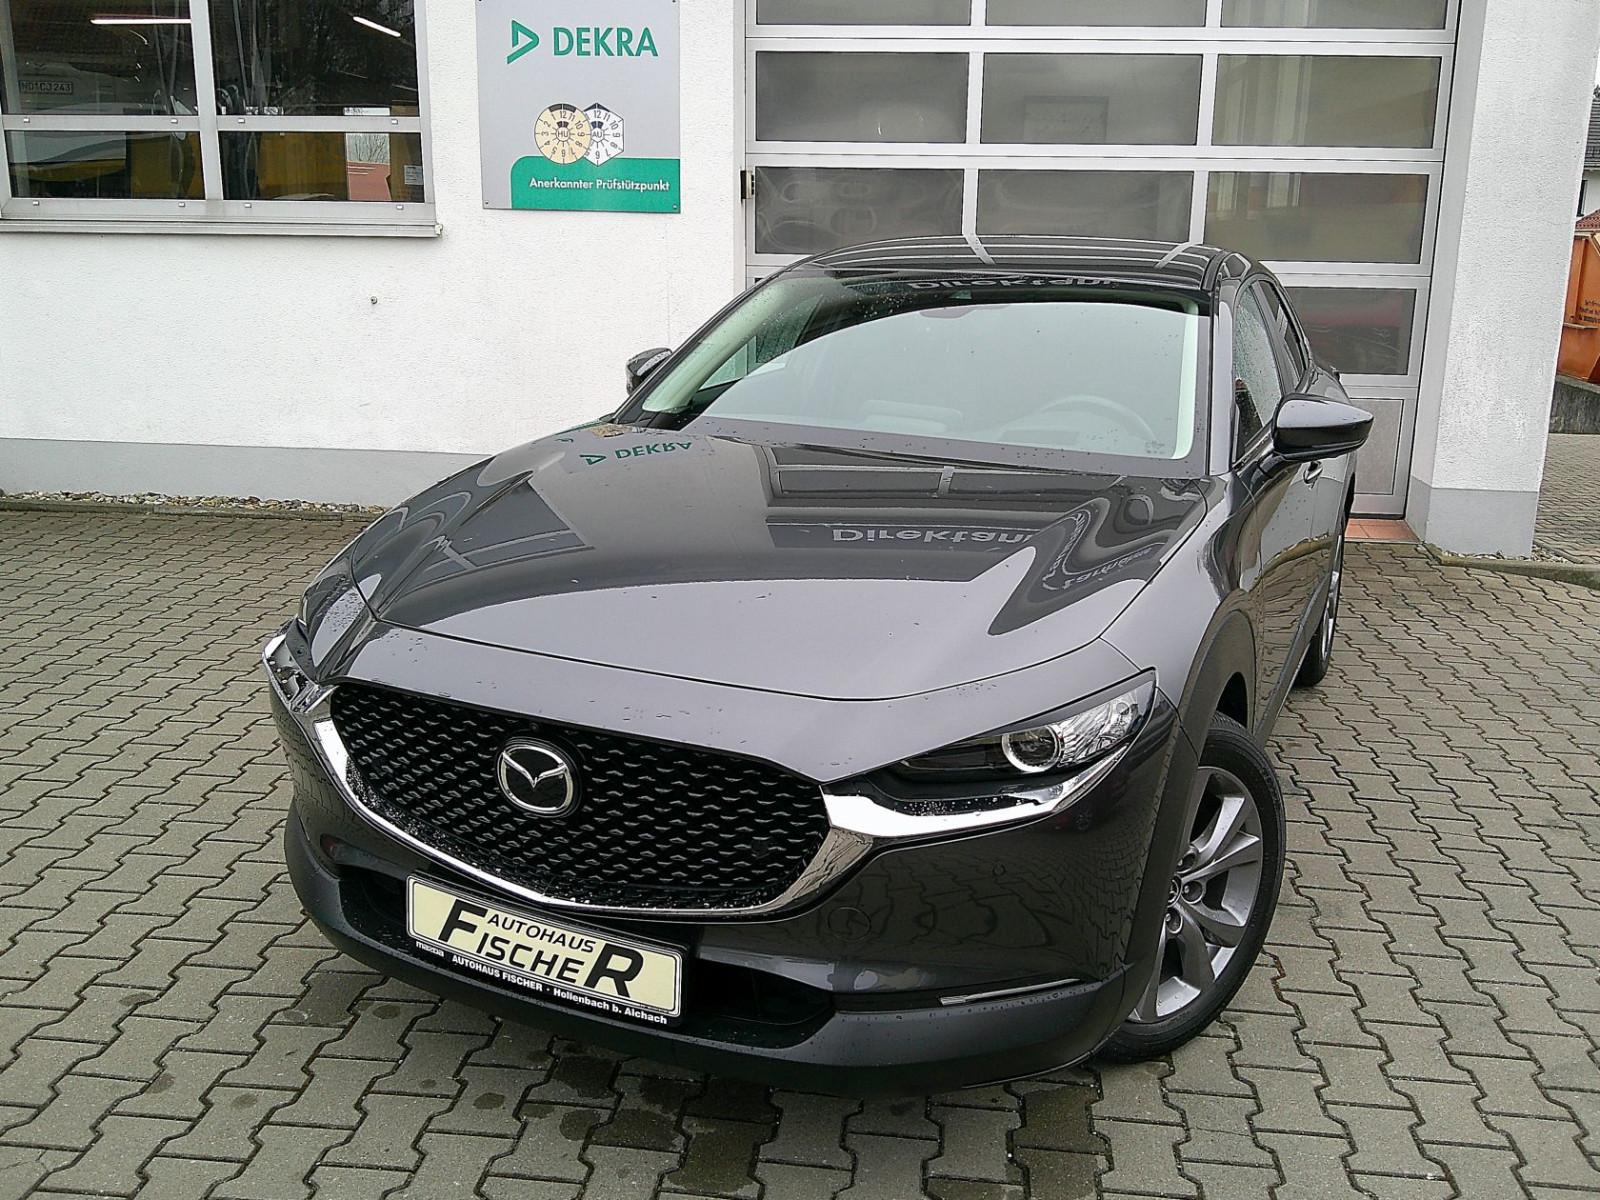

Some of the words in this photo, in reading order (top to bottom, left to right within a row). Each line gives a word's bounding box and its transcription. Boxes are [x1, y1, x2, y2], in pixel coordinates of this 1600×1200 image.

[553, 27, 659, 57] DEKRA
[560, 111, 567, 119] 12
[593, 110, 602, 119] 12
[529, 177, 593, 189] Anerkannter
[596, 179, 670, 192] Prüfstützpunkt
[487, 913, 596, 953] AUTOHAUS
[415, 941, 445, 958] mazda
[438, 898, 644, 998] FISCHER
[452, 955, 500, 978] AUTOHAUS
[502, 972, 543, 992] FISCHER
[553, 988, 609, 1010] Hollenbach
[612, 1004, 622, 1014] b.
